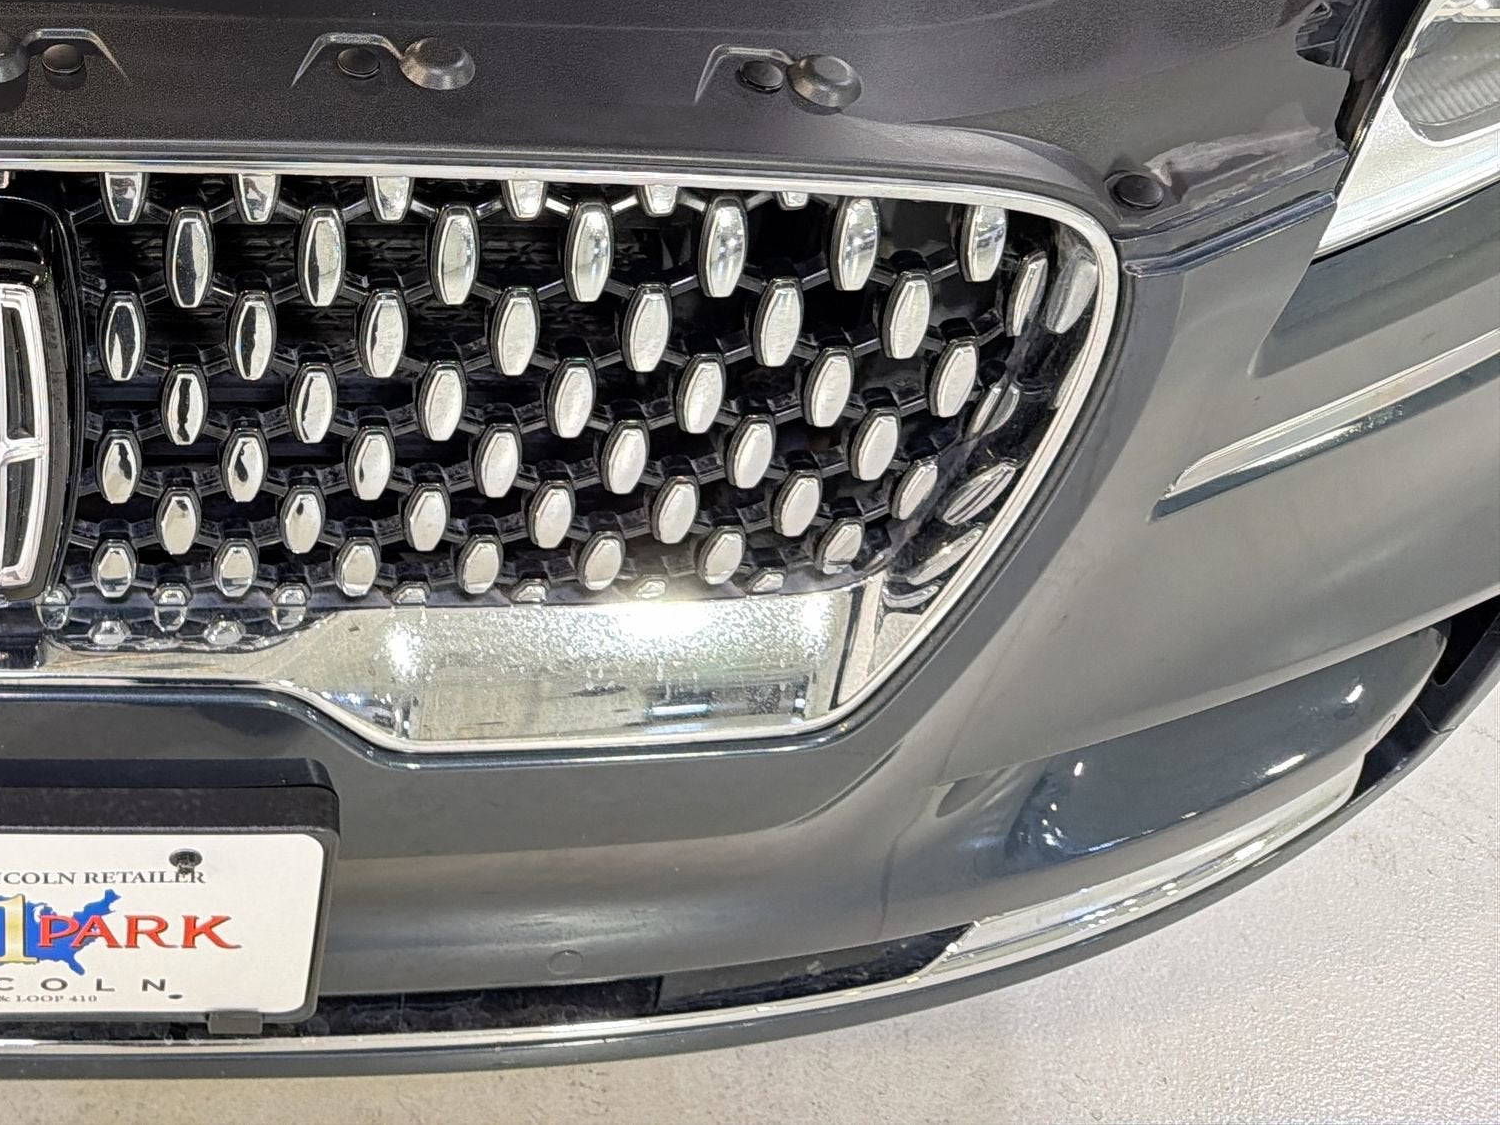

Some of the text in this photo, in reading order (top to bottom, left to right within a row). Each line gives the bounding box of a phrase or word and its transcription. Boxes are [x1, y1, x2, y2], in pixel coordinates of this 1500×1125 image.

[84, 871, 206, 884] RETAILER
[36, 914, 242, 950] PARK
[16, 994, 64, 1003] LOOP
[68, 994, 98, 1002] 410
